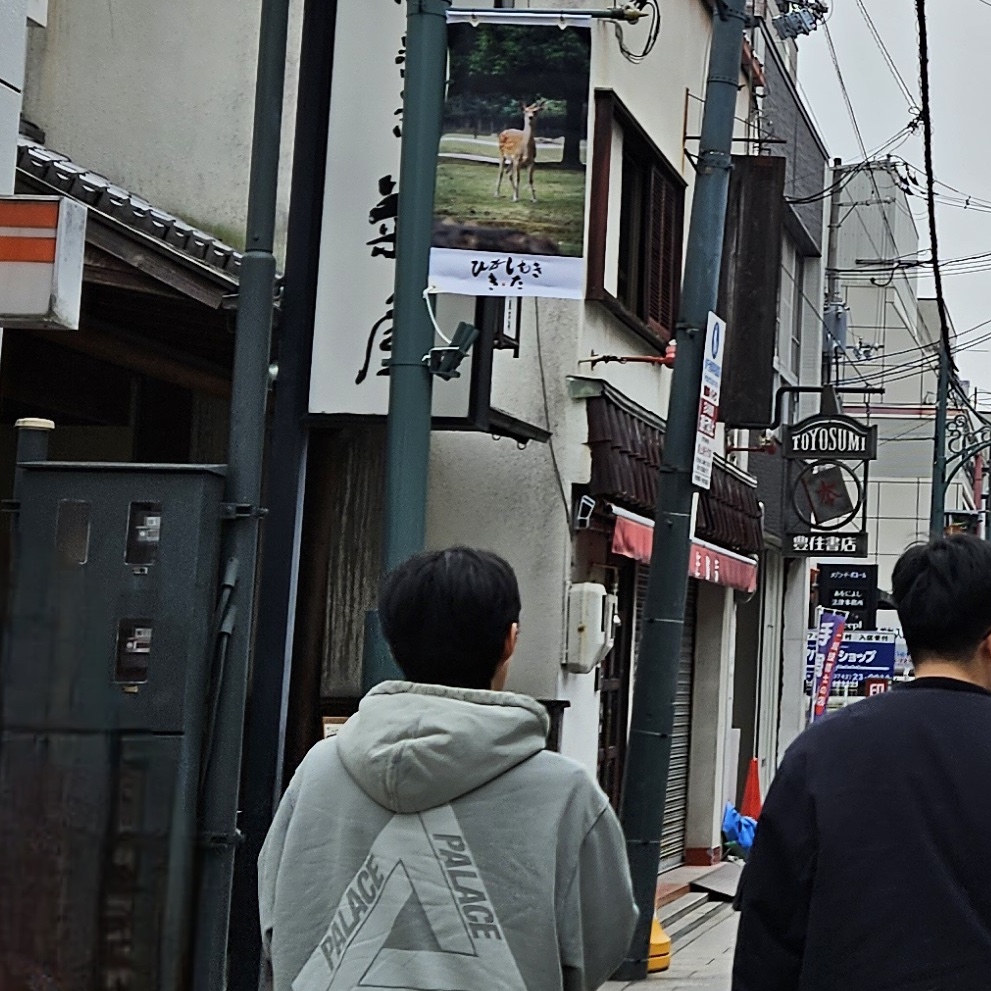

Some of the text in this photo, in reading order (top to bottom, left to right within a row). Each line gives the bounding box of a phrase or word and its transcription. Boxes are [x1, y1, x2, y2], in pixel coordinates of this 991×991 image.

[791, 427, 866, 452] TOYOSUMI
[792, 535, 857, 552] 豊住書店
[320, 853, 385, 972] PALACE
[432, 833, 502, 941] PALACE
